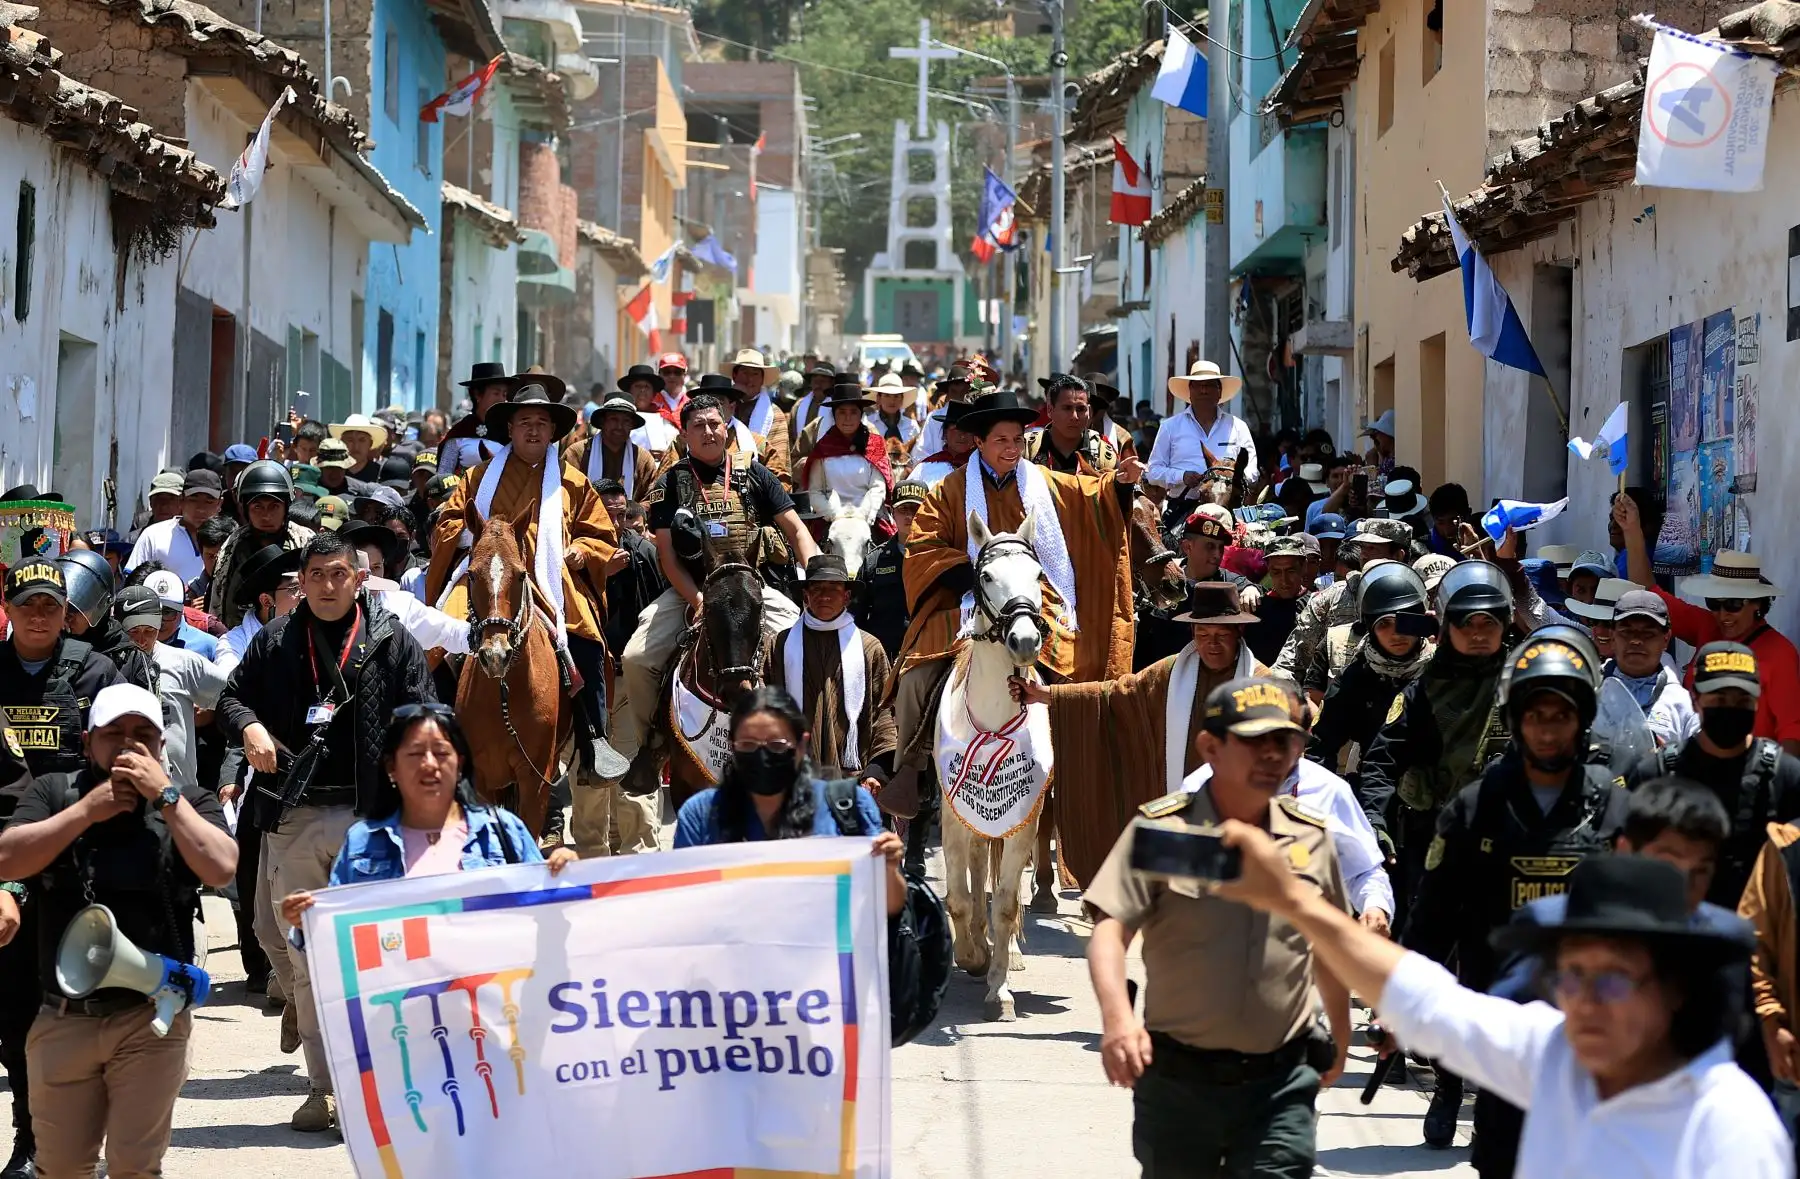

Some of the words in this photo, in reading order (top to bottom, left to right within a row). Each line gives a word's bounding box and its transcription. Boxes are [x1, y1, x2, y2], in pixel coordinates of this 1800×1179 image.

[897, 484, 926, 499] POLICIA
[15, 564, 62, 587] POLICIA
[1516, 643, 1584, 670] POLICIA
[17, 729, 55, 746] OLICIA
[709, 735, 726, 749] PABLO
[713, 759, 721, 768] DE
[1016, 751, 1027, 763] DE
[1004, 759, 1036, 782] HUAYTALLA
[962, 781, 985, 800] ERECHO
[985, 774, 1035, 803] CONSTITUCIONAL
[962, 790, 975, 810] LOS
[976, 786, 1030, 821] DESCENDIENTES
[548, 978, 831, 1040] Siempre
[555, 1058, 611, 1083] con
[620, 1049, 648, 1076] el
[654, 1035, 834, 1091] pueblo
